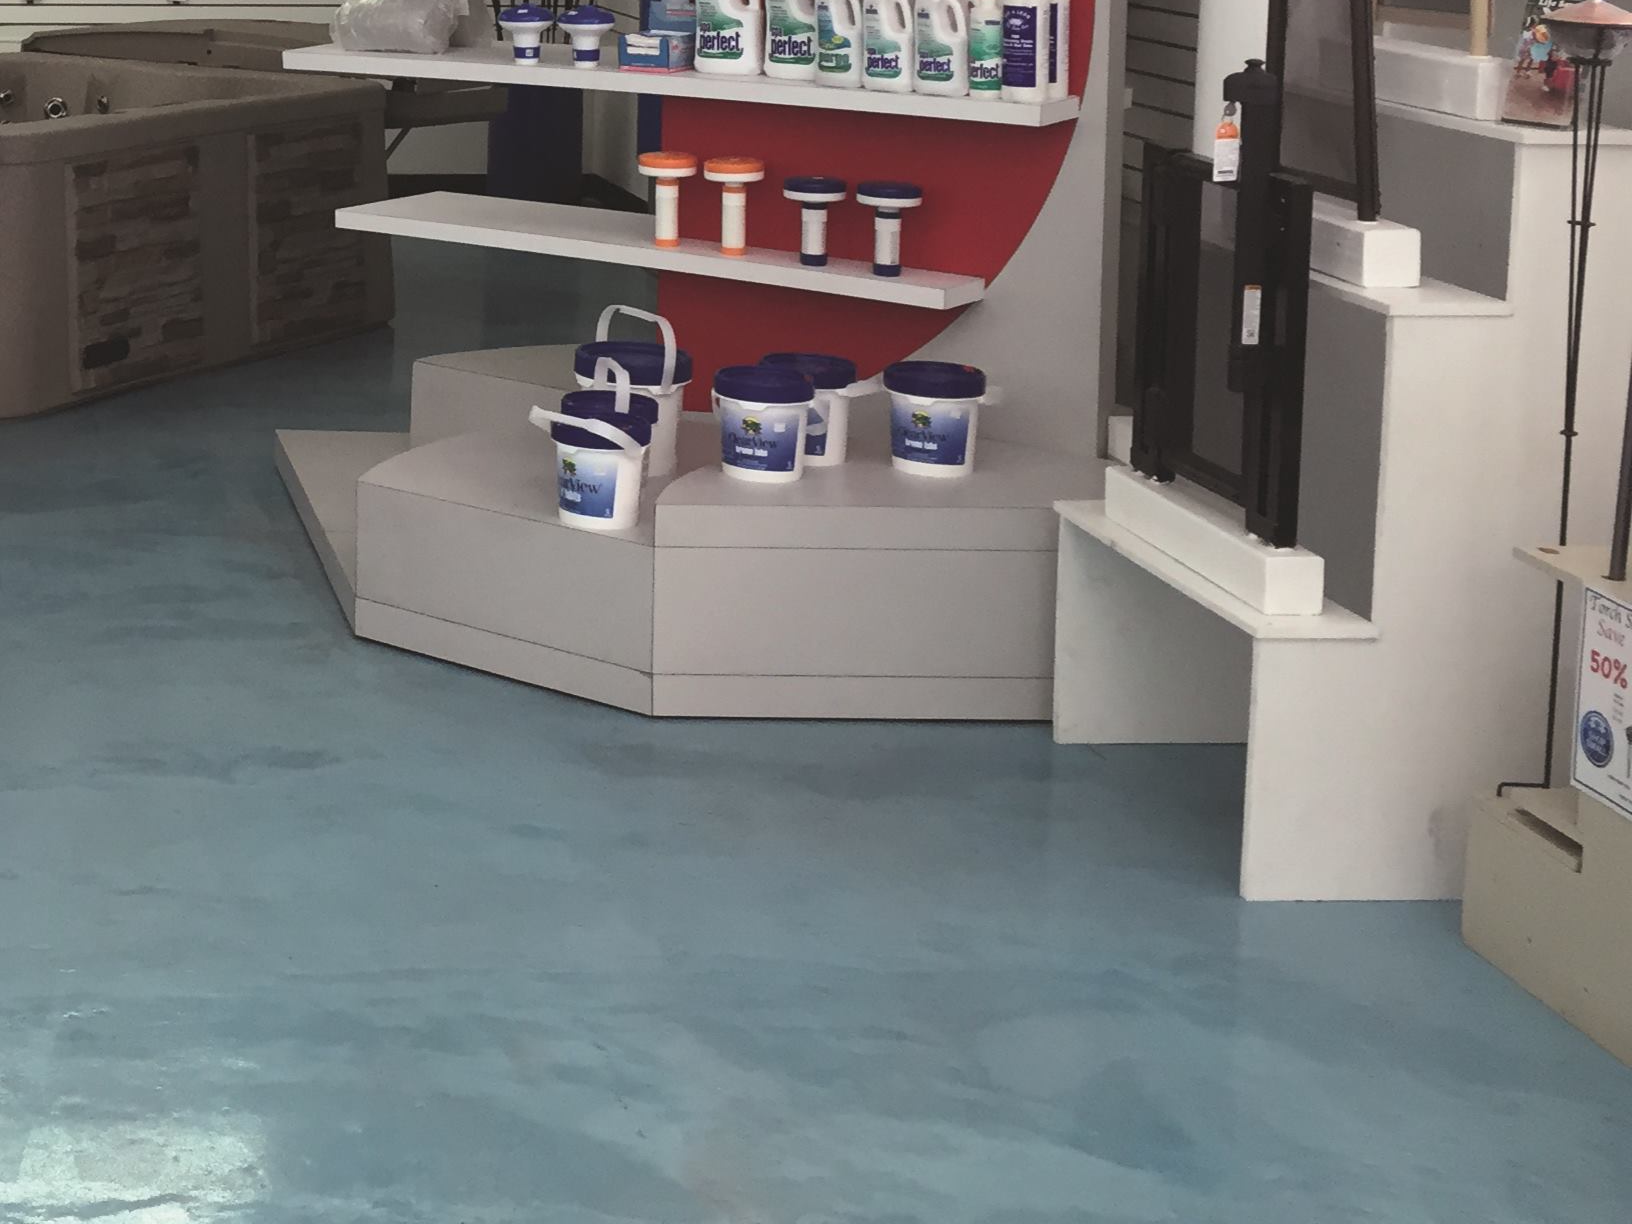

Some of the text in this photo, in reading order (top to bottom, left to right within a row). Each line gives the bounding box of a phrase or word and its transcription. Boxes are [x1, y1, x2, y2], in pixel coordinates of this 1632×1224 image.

[699, 31, 741, 55] perfect
[770, 36, 813, 59] perfect
[867, 55, 899, 72] perfect
[918, 58, 951, 75] perfect
[970, 63, 1000, 80] erfect
[1589, 594, 1622, 624] Torch
[1596, 618, 1626, 647] Save
[1590, 649, 1628, 690] 50%
